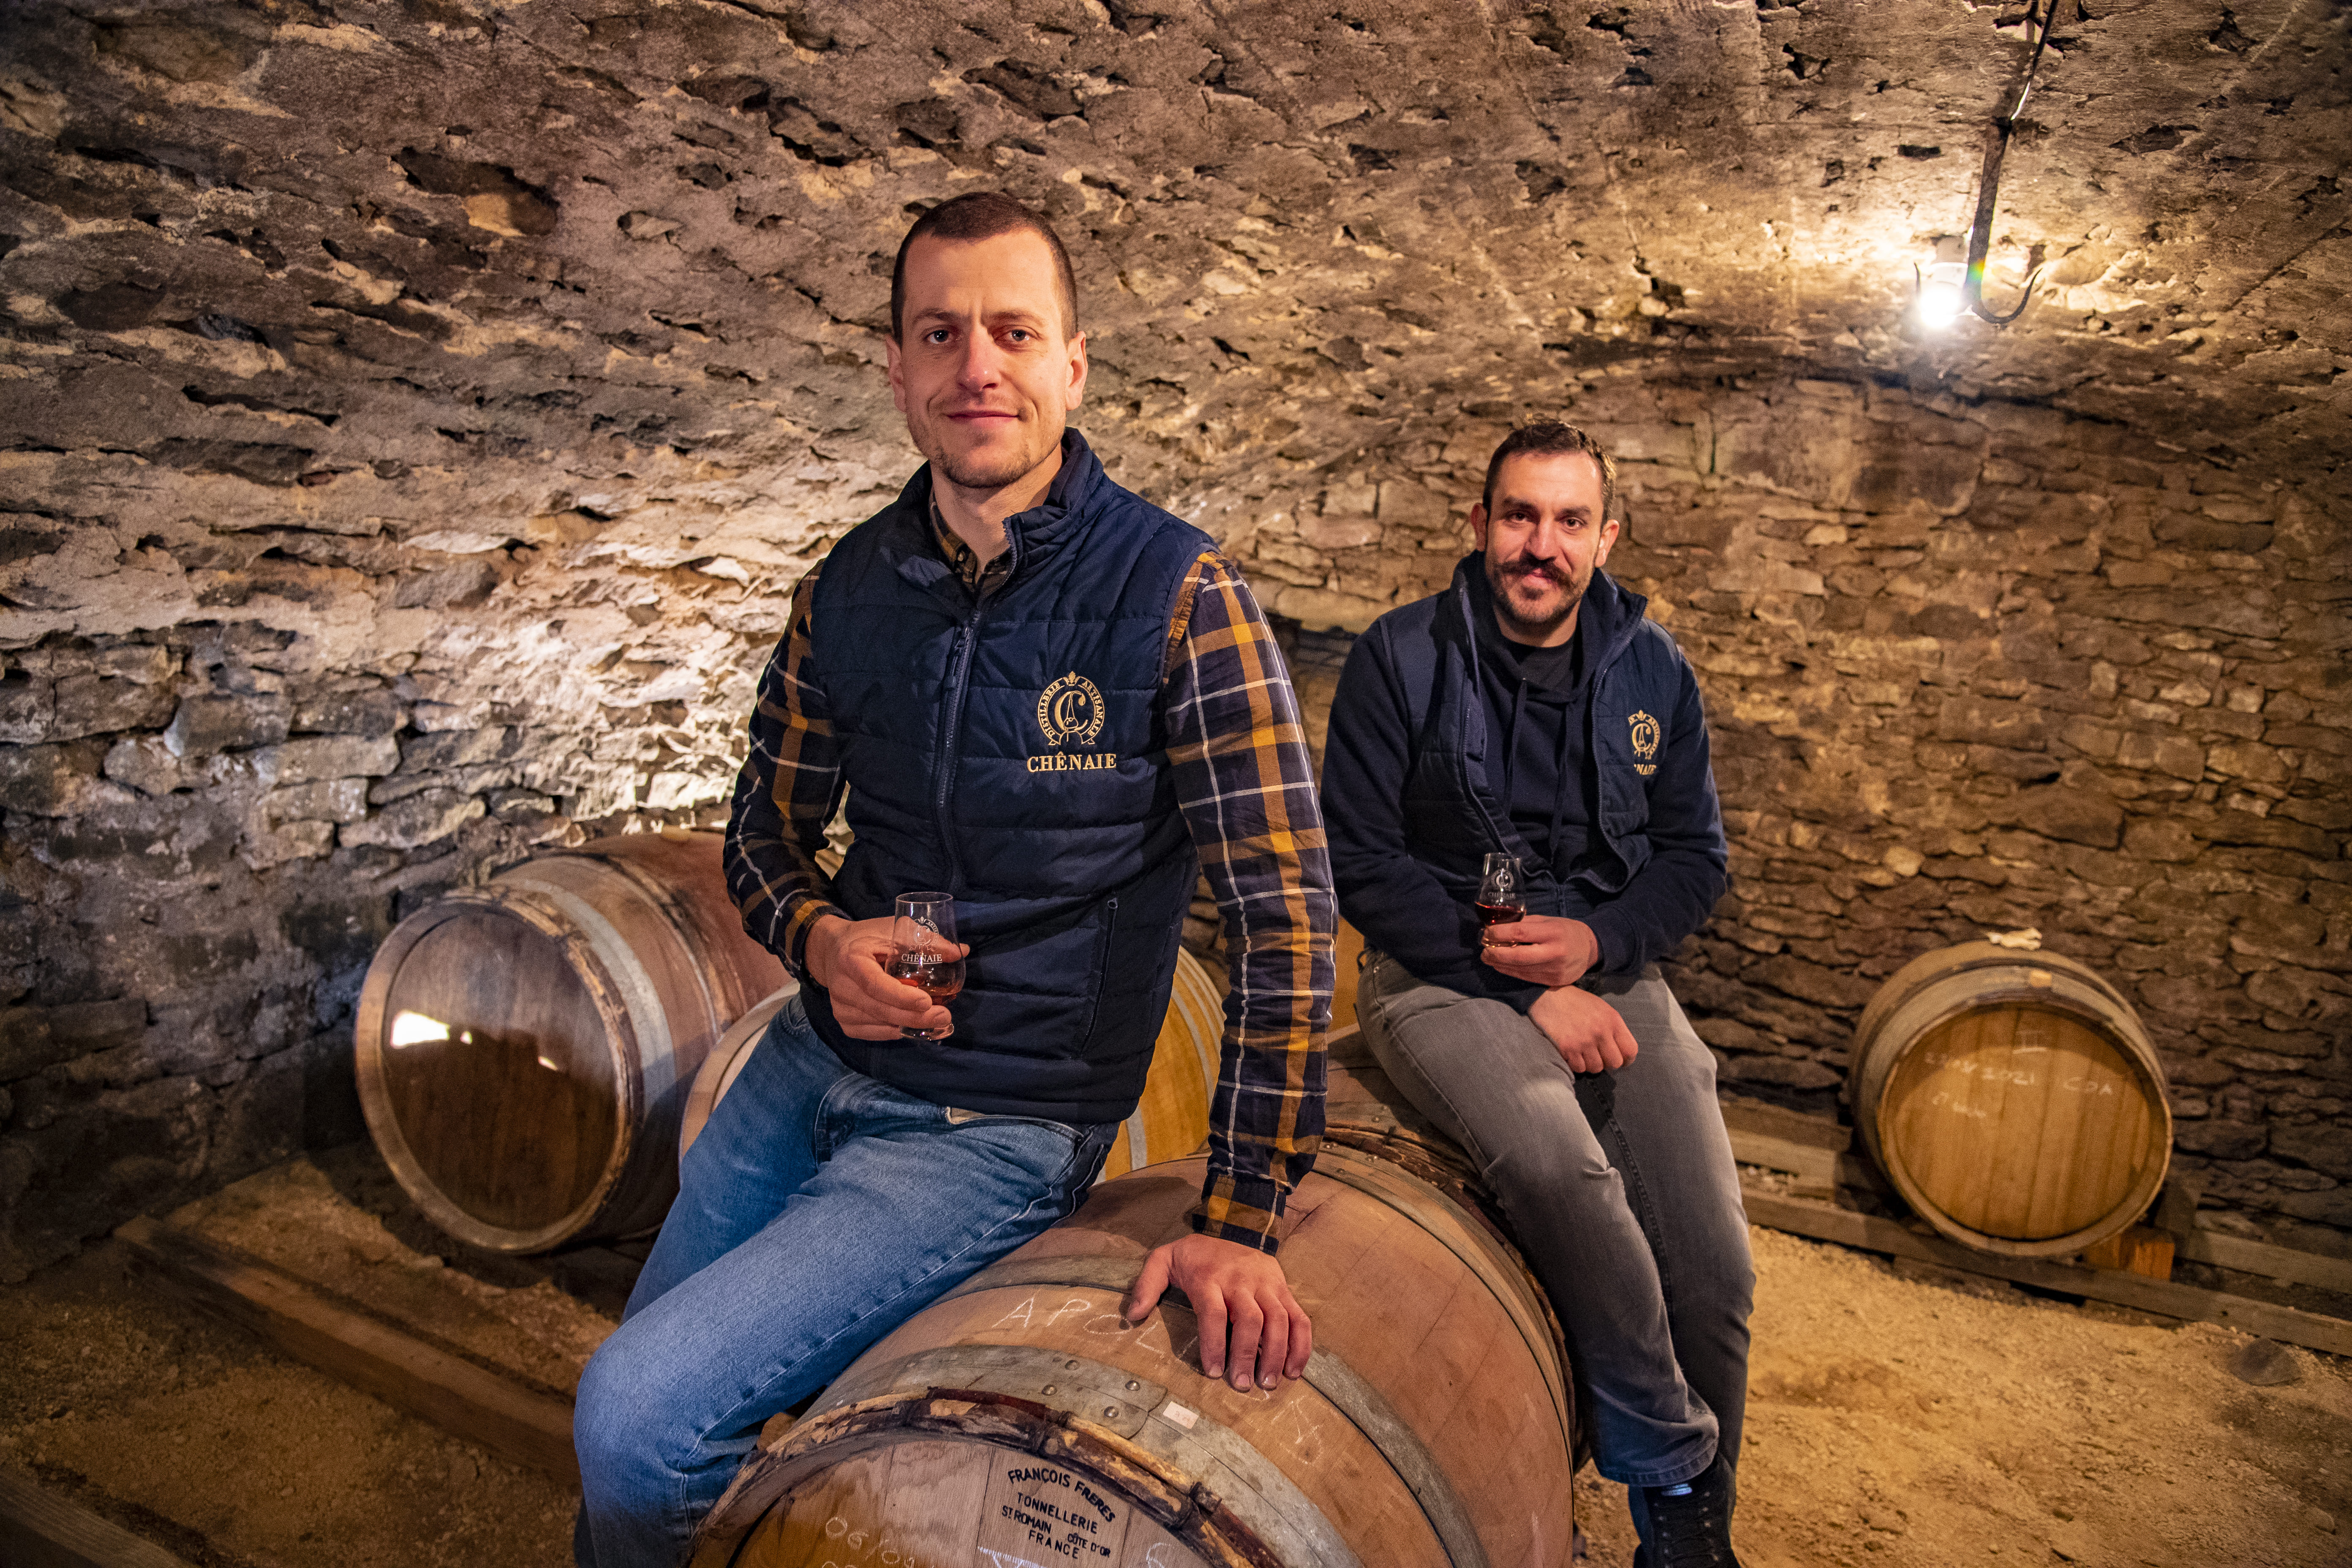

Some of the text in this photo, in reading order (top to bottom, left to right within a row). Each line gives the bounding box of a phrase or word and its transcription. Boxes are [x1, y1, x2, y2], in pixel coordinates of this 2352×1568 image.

[1040, 680, 1103, 738] DISTILLERIE ARTISANALE
[1027, 751, 1116, 773] CHÊNAIE
[901, 953, 942, 962] CHÊNAIE
[1014, 1509, 1051, 1534] ROMAIN
[1018, 1492, 1097, 1534] TONNELLERIE
[1028, 1529, 1079, 1559] FRANCE
